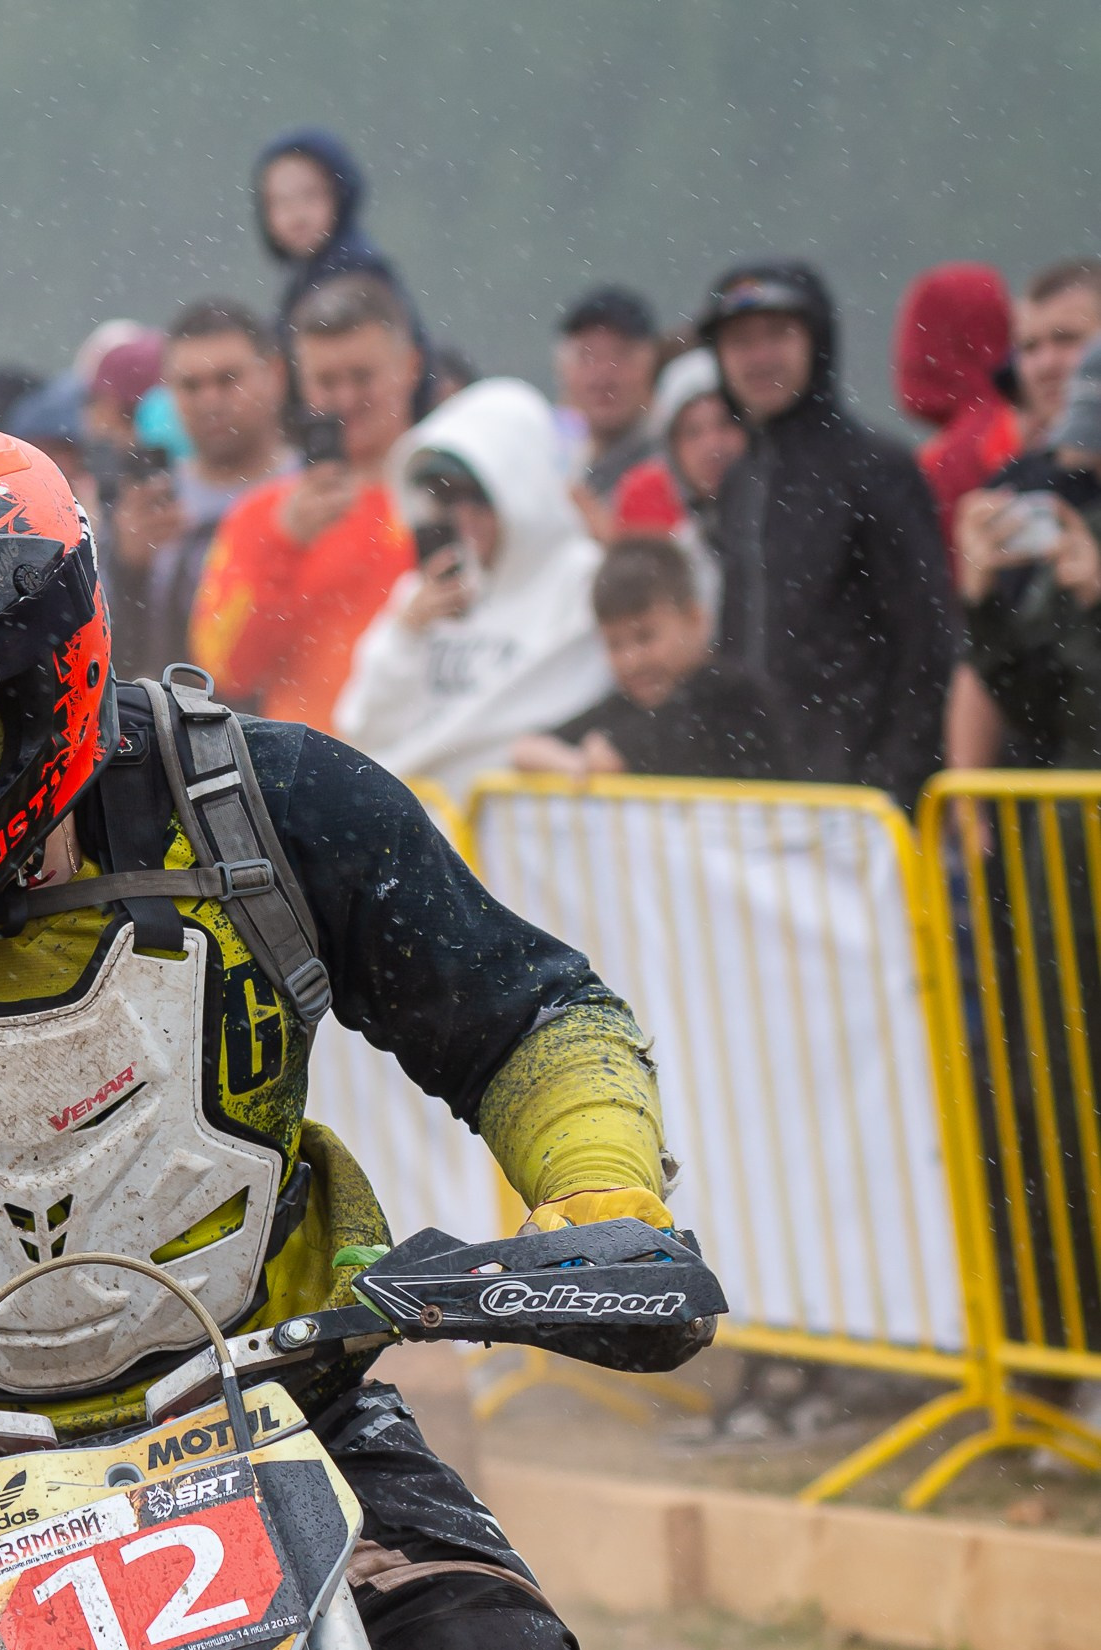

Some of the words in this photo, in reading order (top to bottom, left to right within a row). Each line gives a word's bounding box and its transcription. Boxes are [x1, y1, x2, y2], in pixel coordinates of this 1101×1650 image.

[48, 1066, 135, 1132] VEMAR
[479, 1281, 686, 1316] Polisport
[175, 1471, 240, 1506] SRT
[237, 1628, 249, 1638] 14
